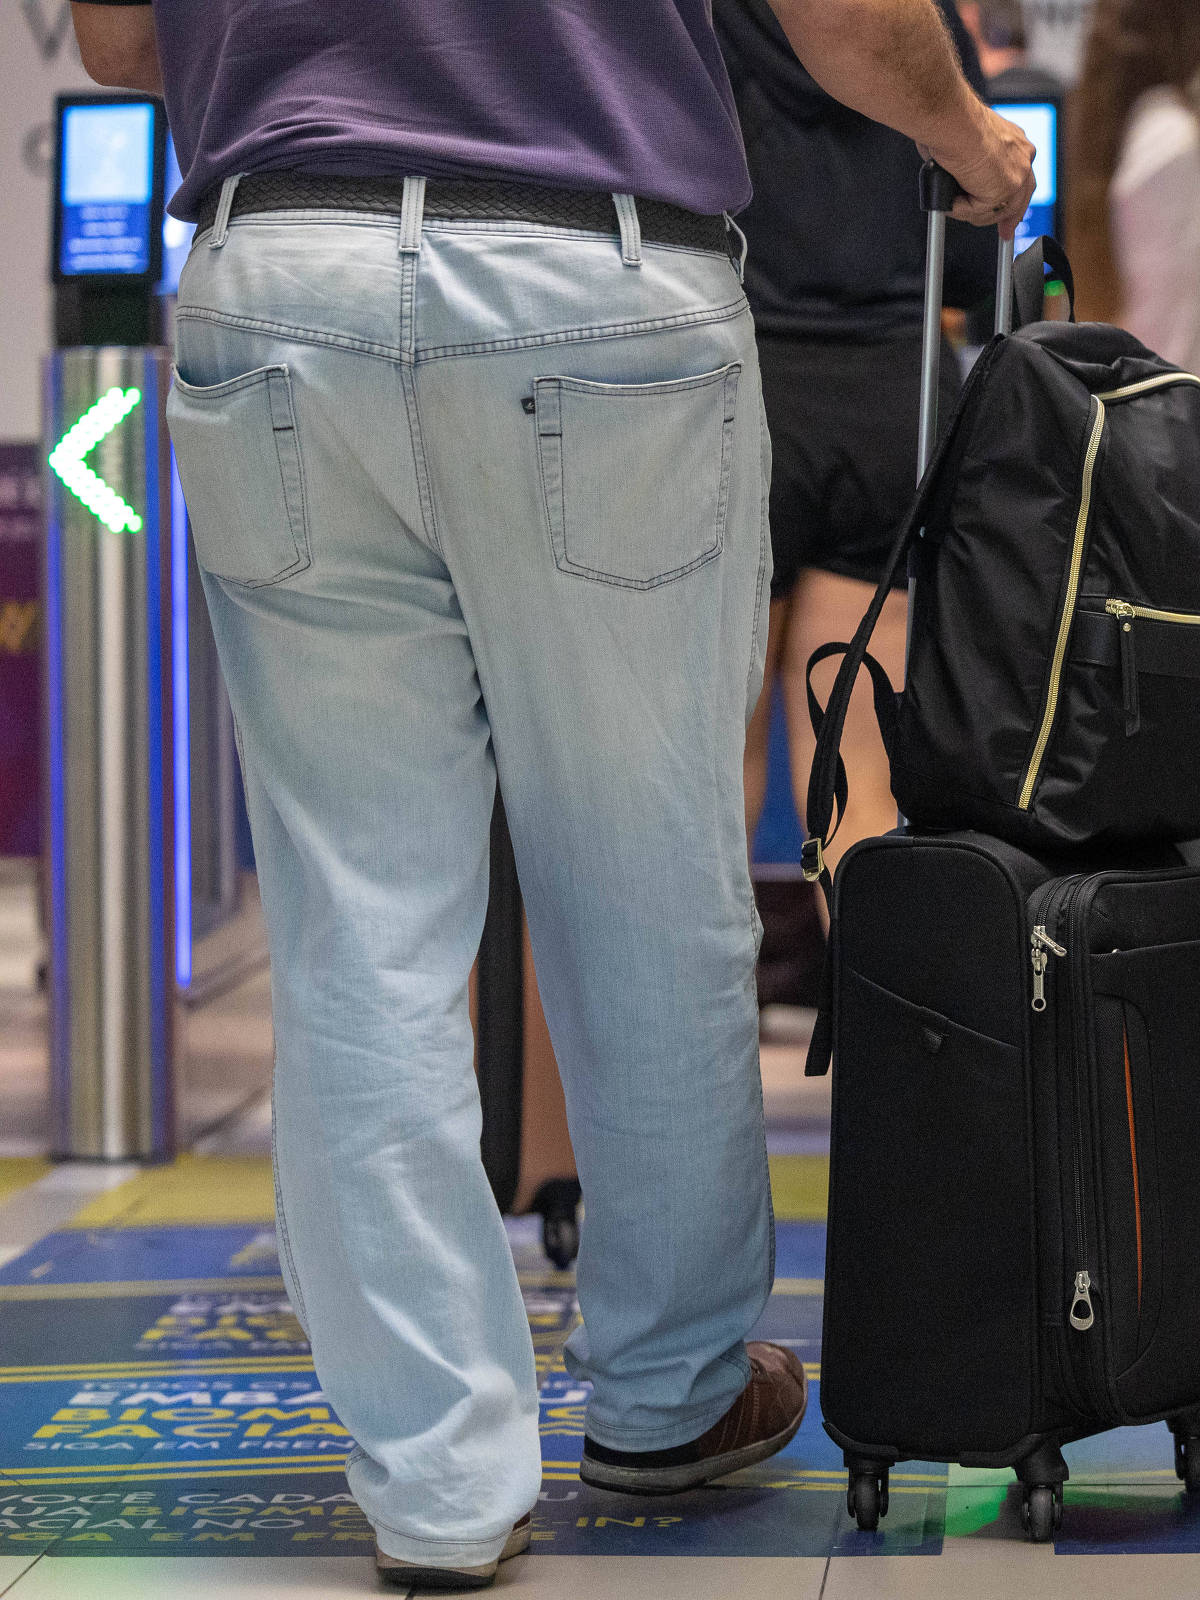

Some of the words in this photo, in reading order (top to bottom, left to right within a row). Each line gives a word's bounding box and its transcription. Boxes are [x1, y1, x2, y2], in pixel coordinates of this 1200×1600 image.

[32, 1422, 352, 1438] FACIA
[23, 1441, 134, 1450] SIGA
[152, 1441, 220, 1449] EM
[238, 1440, 357, 1449] FREN
[1, 1506, 93, 1517] UA
[119, 1505, 365, 1517] BIOME
[190, 1518, 304, 1529] NO
[150, 1532, 256, 1542] EM
